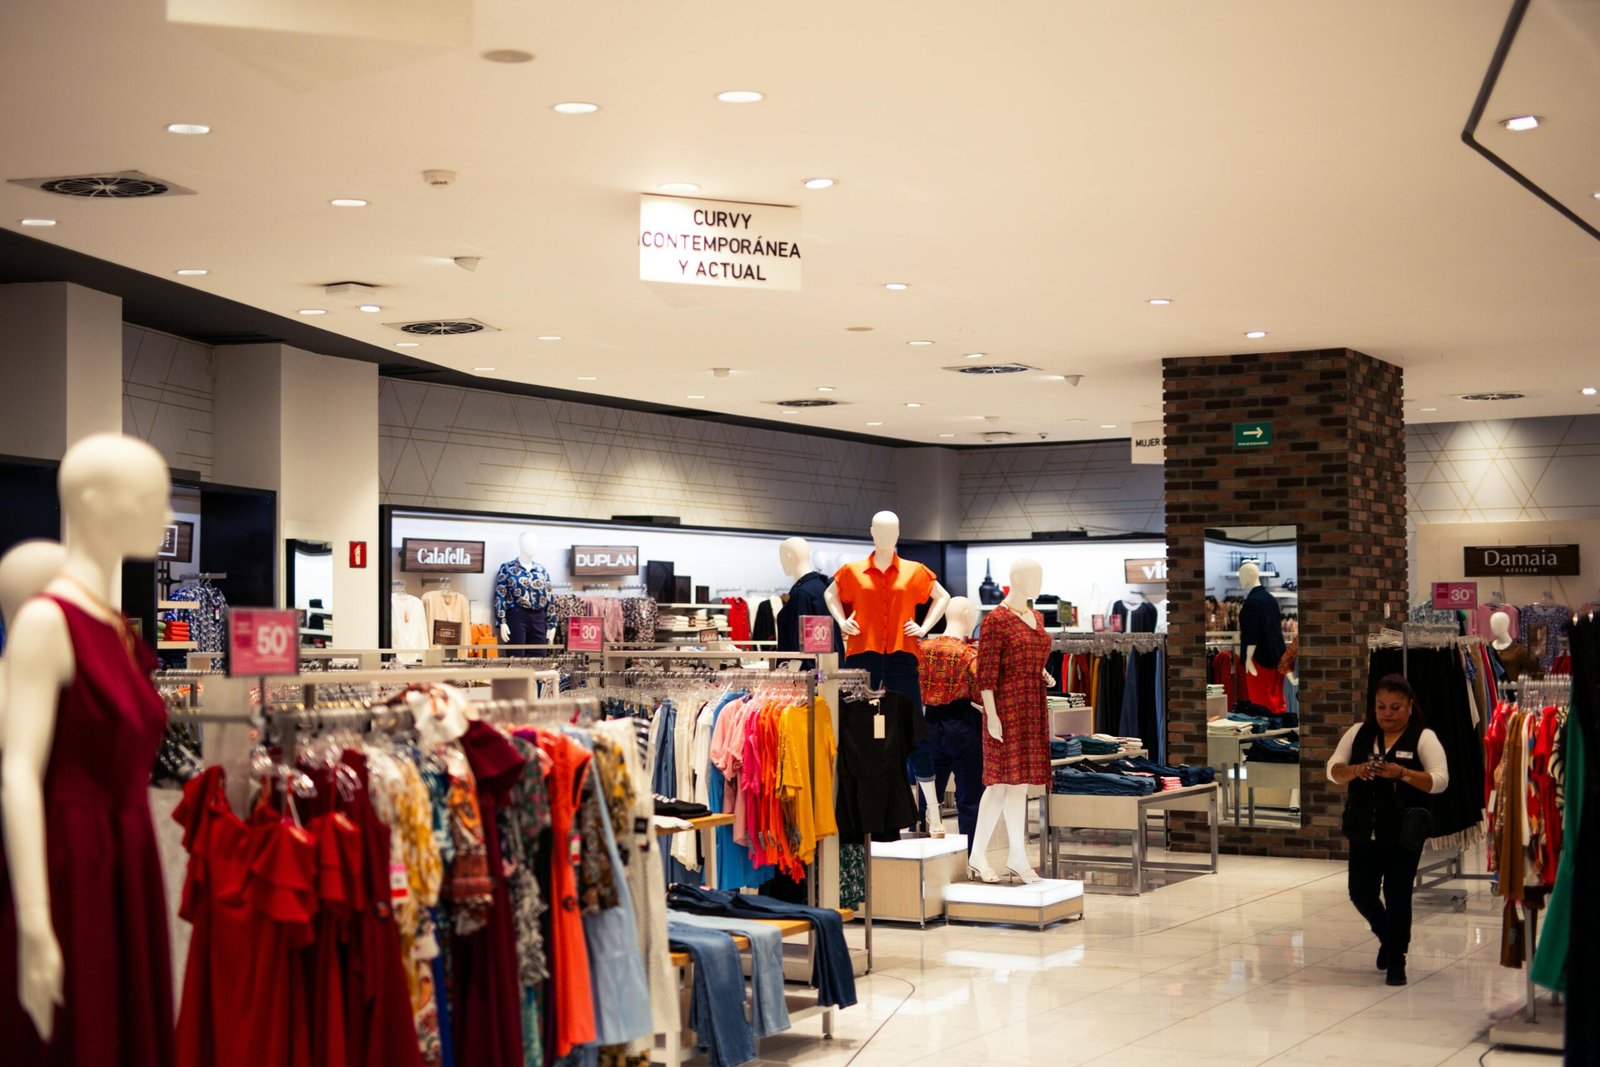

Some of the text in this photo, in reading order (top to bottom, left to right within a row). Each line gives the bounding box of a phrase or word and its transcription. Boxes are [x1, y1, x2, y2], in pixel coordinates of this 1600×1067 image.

[693, 209, 752, 230] CURVY
[641, 230, 801, 259] CONTEMPORÁNEA
[678, 259, 767, 281] Y ACTUAL
[1135, 438, 1161, 448] MUJER
[416, 547, 472, 565] Calafella
[575, 553, 637, 567] DUPLAN
[1484, 549, 1558, 567] Damaia
